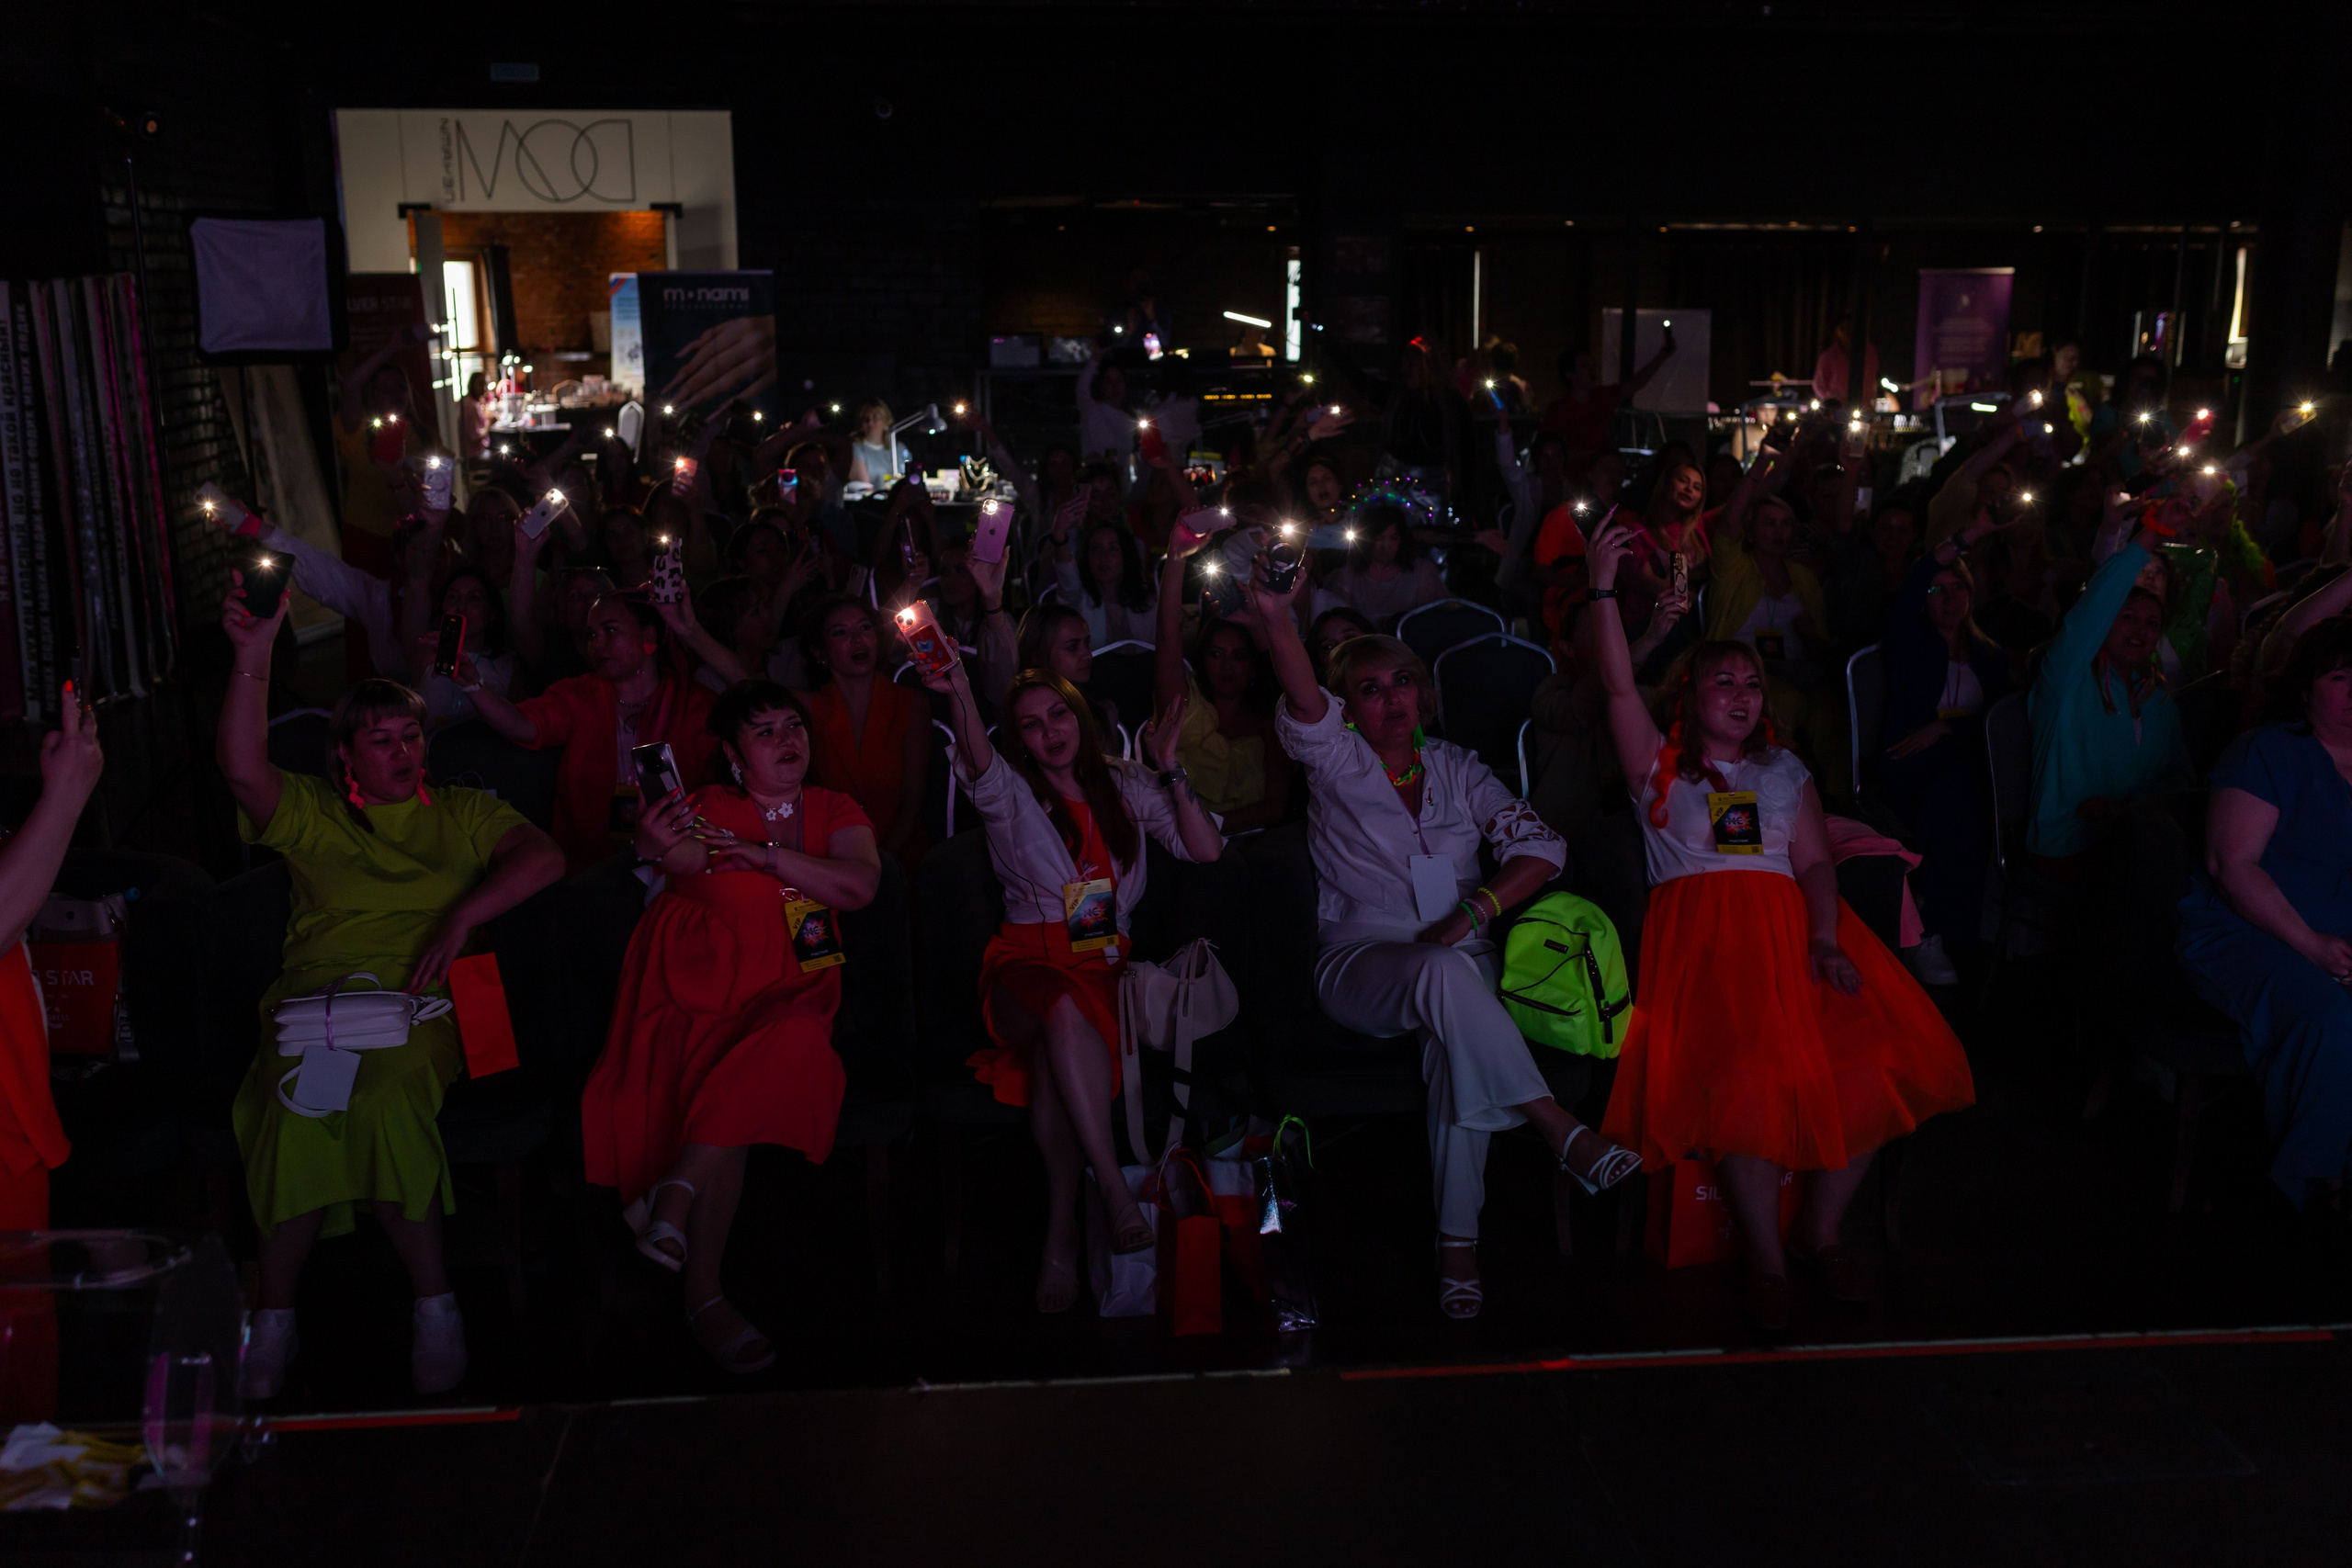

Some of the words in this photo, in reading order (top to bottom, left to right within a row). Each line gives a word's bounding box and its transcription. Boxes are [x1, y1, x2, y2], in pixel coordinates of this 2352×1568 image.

[1713, 807, 1724, 817] VIP
[1069, 898, 1080, 910] VIP
[793, 918, 801, 930] VIP
[45, 969, 95, 986] STAR
[1695, 1185, 1723, 1201] SIL
